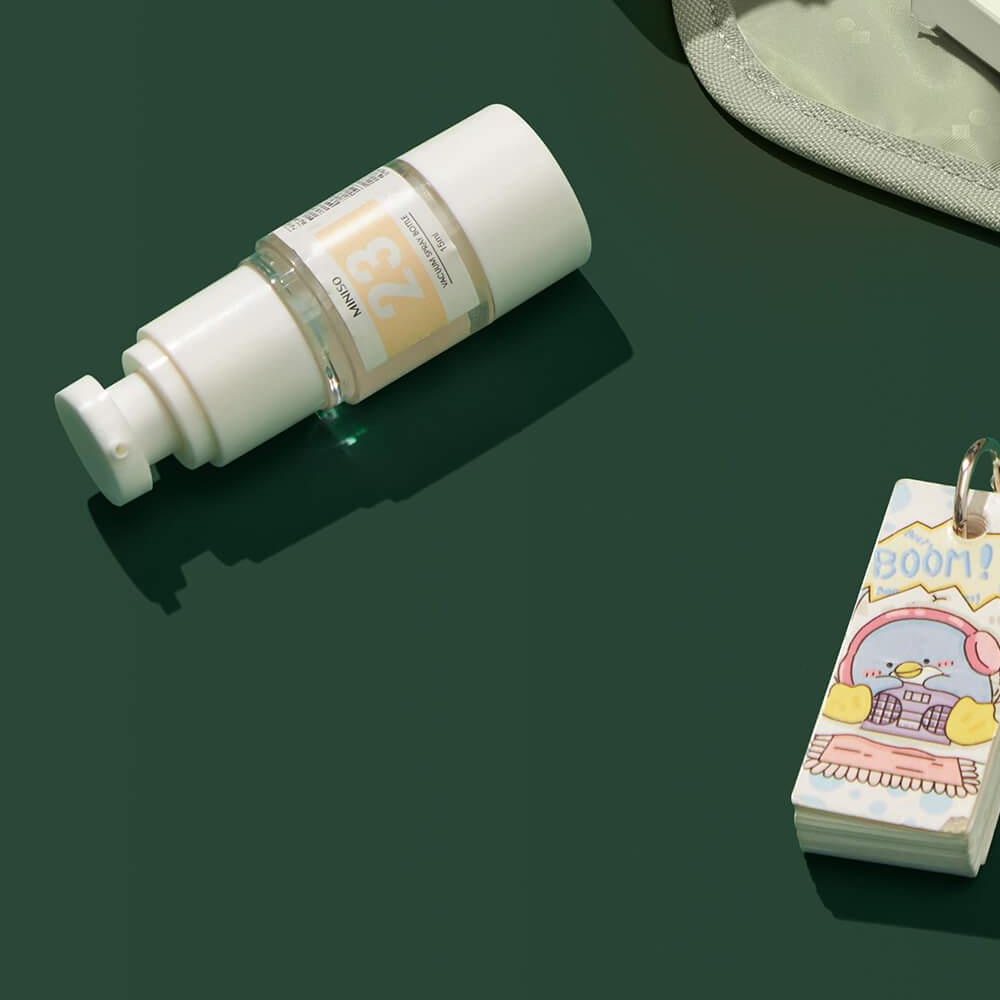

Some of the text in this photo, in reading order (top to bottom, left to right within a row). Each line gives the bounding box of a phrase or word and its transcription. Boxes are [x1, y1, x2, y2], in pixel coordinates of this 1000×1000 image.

[400, 214, 449, 289] VACUUM SPRAY BOTTLE
[431, 231, 448, 252] 15ml
[331, 276, 362, 318] MINISO
[347, 236, 426, 320] 23
